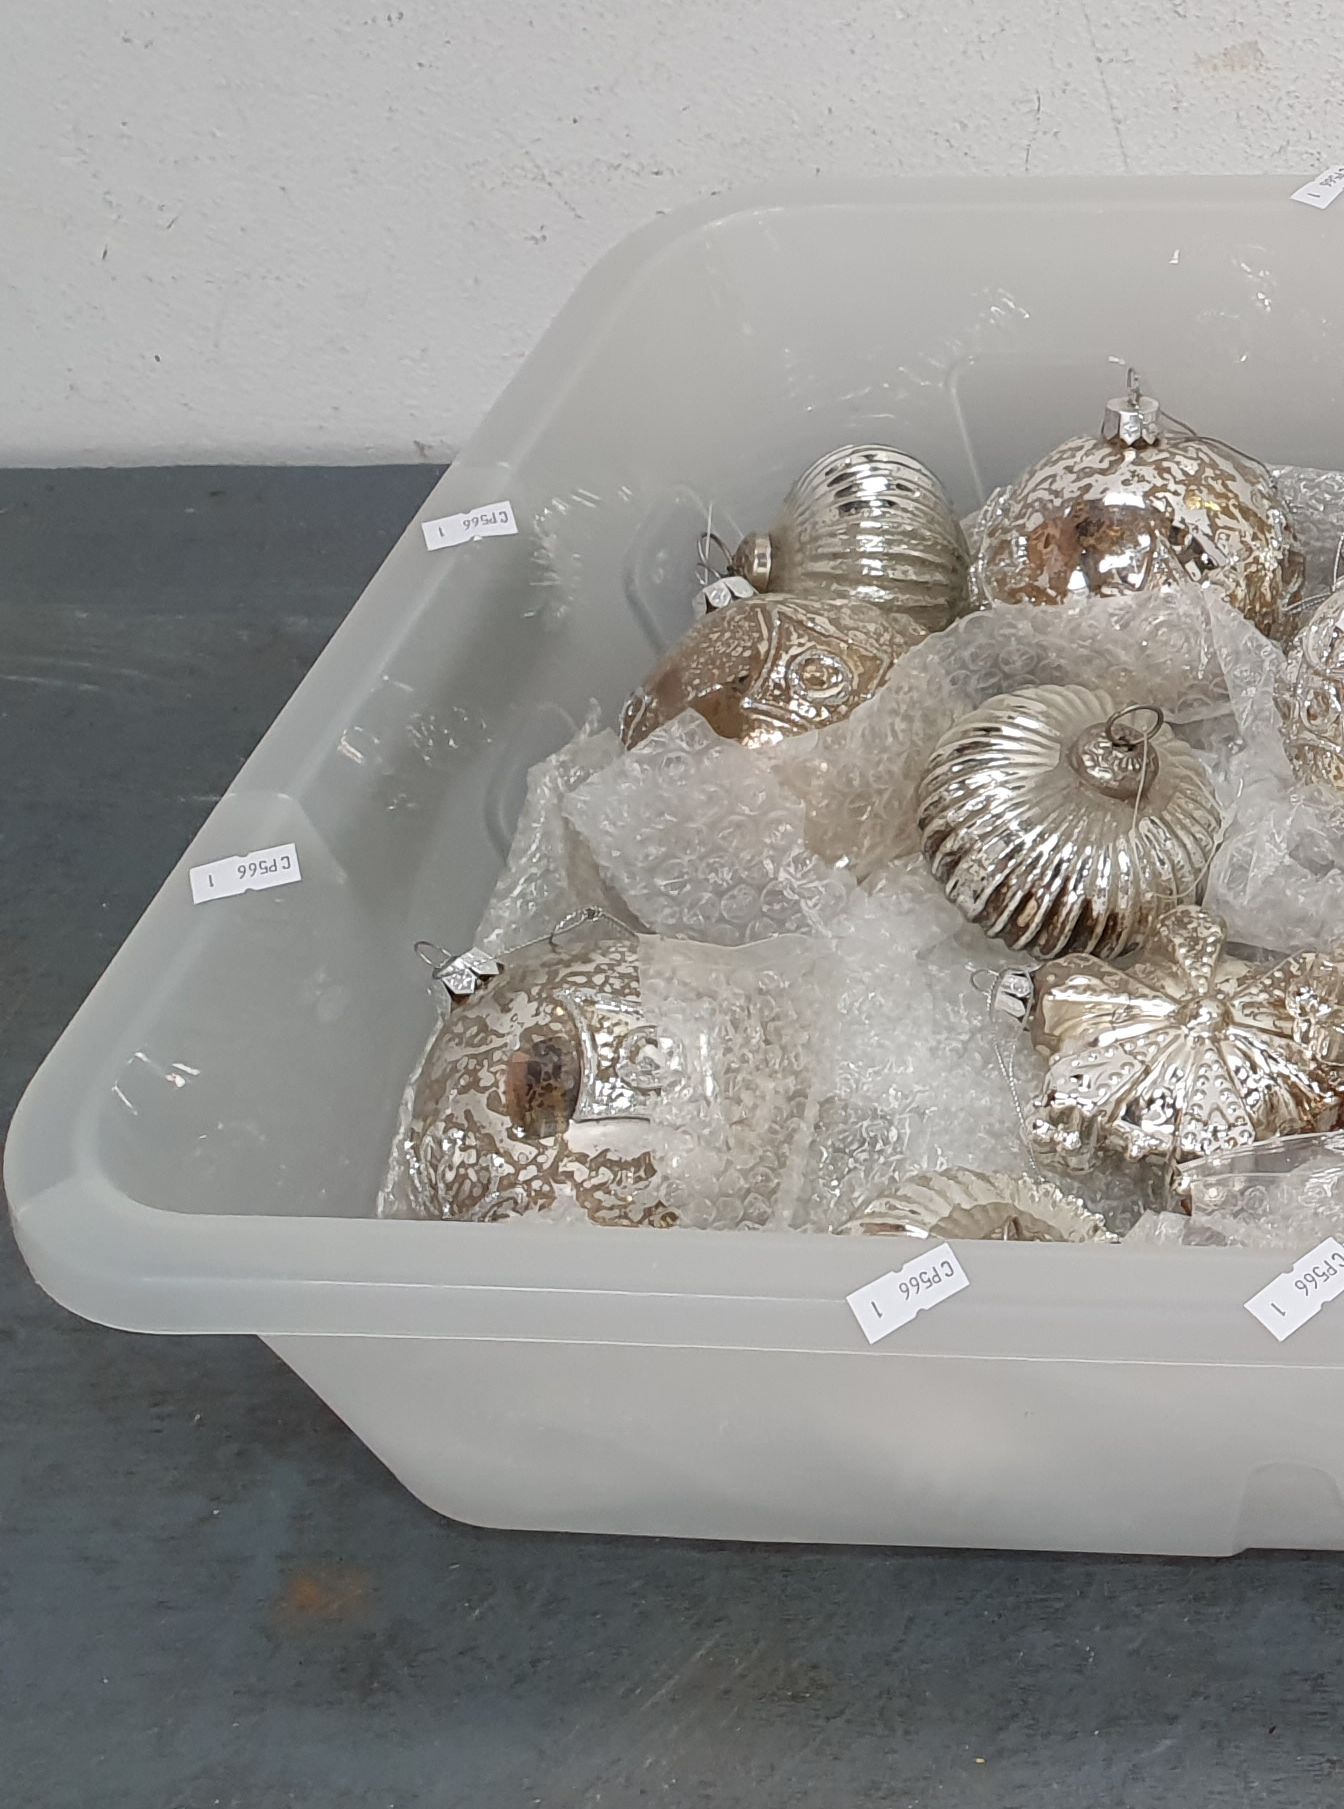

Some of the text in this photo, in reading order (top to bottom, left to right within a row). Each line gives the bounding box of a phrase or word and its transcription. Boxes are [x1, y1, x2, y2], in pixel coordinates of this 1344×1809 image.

[438, 511, 509, 537] CP566 1
[208, 856, 291, 887] CP566 1
[871, 1260, 954, 1318] CP566 1
[1270, 1303, 1286, 1316] 1
